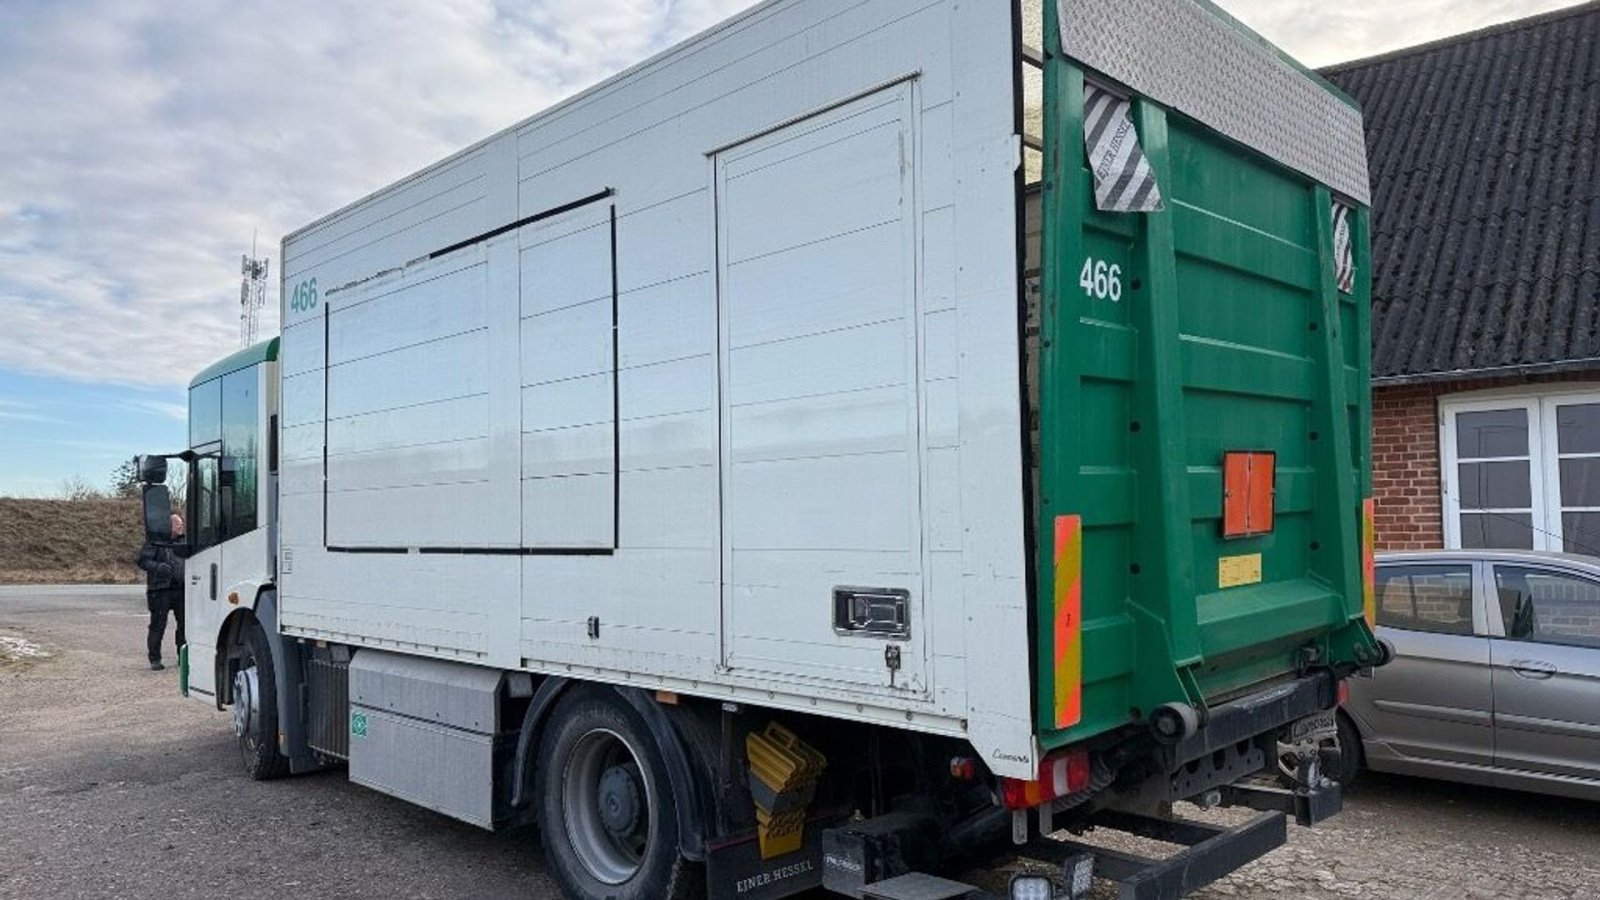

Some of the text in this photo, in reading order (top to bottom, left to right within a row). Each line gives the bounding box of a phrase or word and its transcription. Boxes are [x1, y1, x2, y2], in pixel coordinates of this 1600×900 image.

[291, 276, 318, 314] 466
[1080, 256, 1122, 302] 466
[736, 874, 771, 893] EJNER
[773, 859, 814, 881] HESSEL
